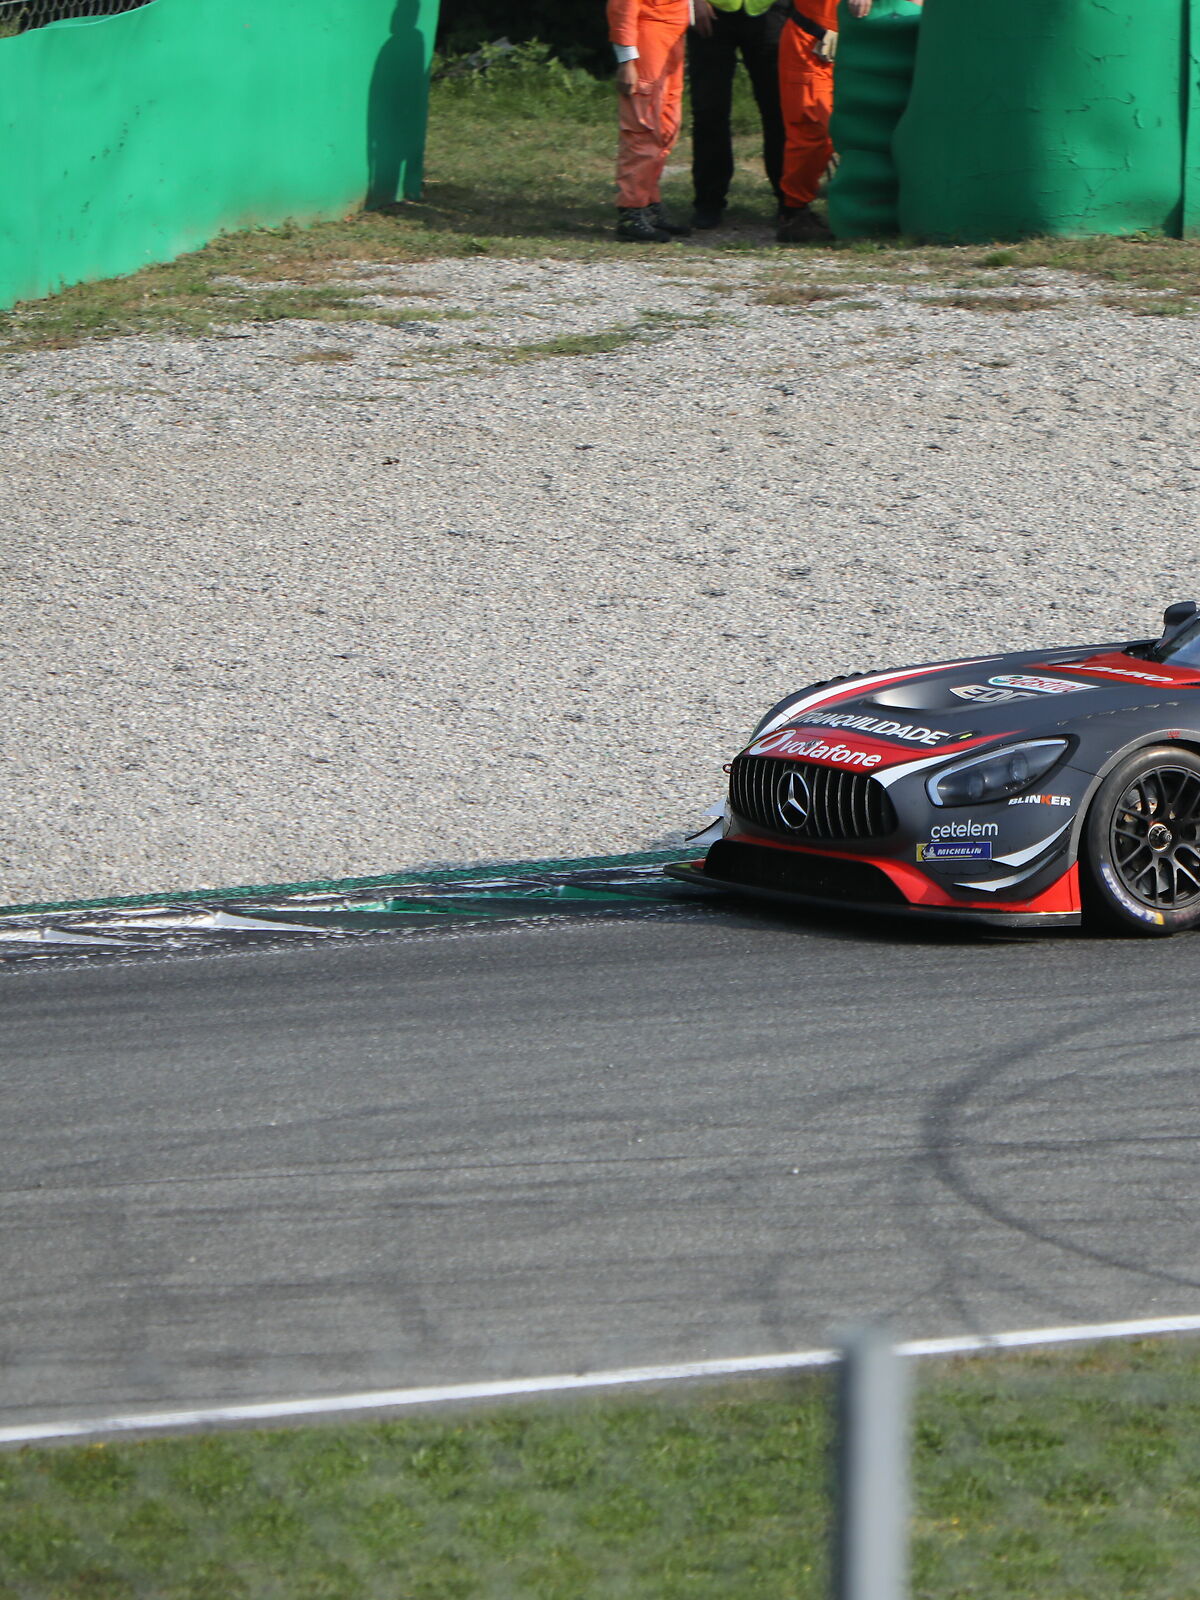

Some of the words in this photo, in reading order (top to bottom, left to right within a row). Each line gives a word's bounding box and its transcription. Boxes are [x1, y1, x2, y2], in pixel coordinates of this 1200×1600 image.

[800, 712, 950, 745] TRANQUILIDADE
[778, 739, 882, 767] vodafone
[1008, 794, 1071, 807] BLINKER
[931, 819, 999, 839] cetelem
[937, 847, 983, 856] MICHELIN
